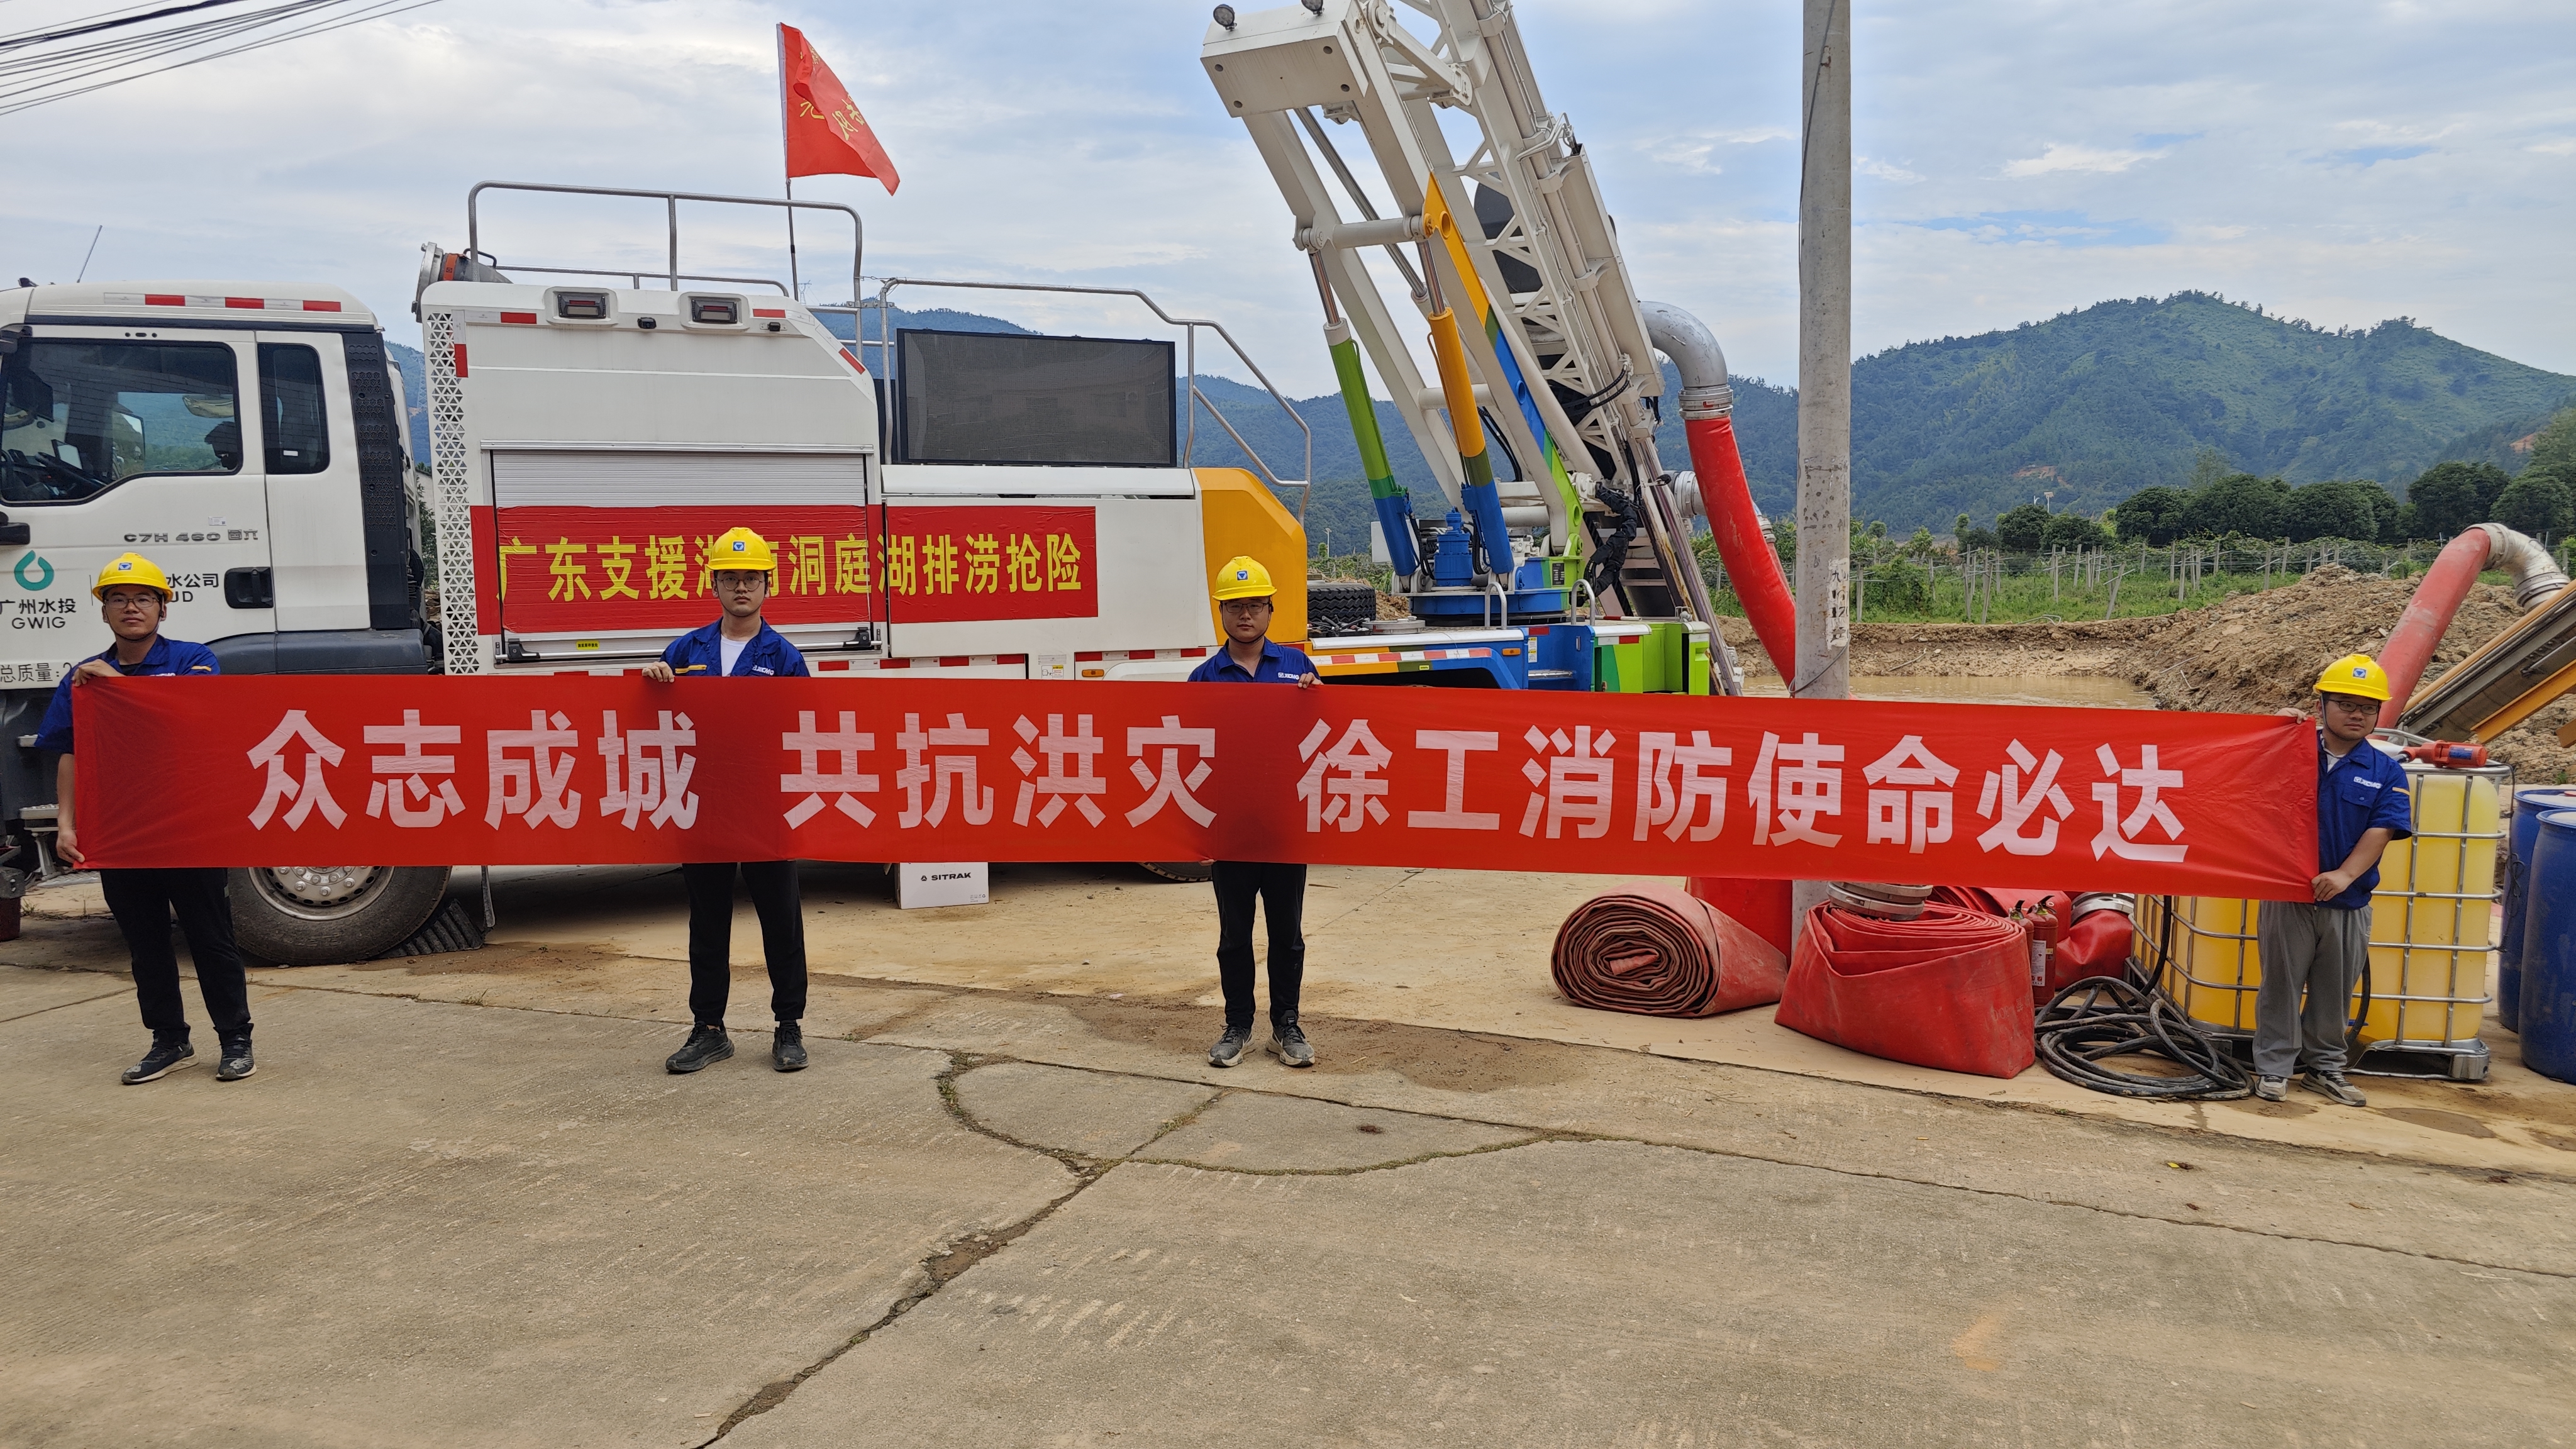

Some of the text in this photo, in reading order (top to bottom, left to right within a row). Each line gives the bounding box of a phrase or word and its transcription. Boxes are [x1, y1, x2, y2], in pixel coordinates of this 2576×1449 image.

[123, 533, 169, 543] C7H
[175, 532, 221, 542] 460
[496, 533, 1082, 602] 广东支援洞庭湖排涝抢险
[0, 597, 77, 615] 广州水投
[11, 616, 66, 630] GWIG
[246, 709, 2189, 863] 众志成城 共抗洪灾 徐工消防使命必达
[931, 872, 971, 881] SITRAK
